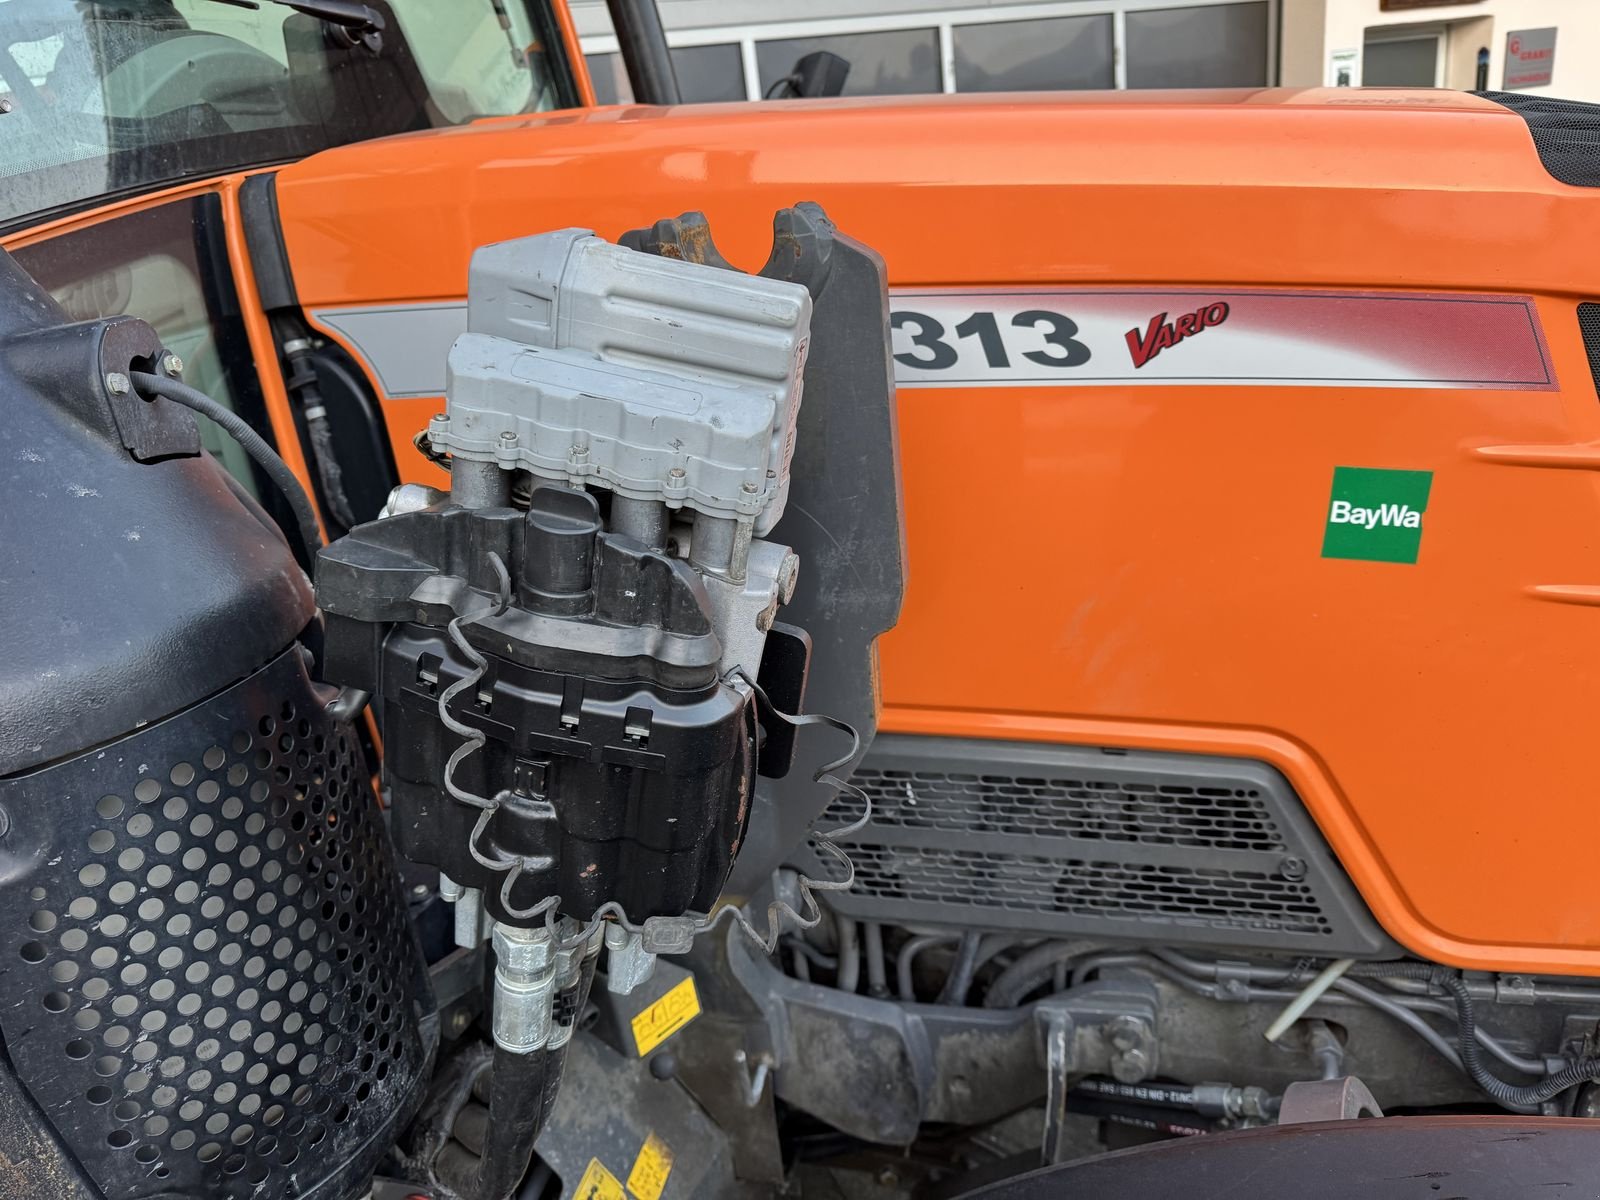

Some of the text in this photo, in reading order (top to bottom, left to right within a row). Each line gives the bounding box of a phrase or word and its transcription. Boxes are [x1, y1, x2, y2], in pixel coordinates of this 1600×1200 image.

[889, 310, 1092, 370] 313
[1124, 302, 1230, 369] VARIO
[1330, 500, 1421, 530] BayWa
